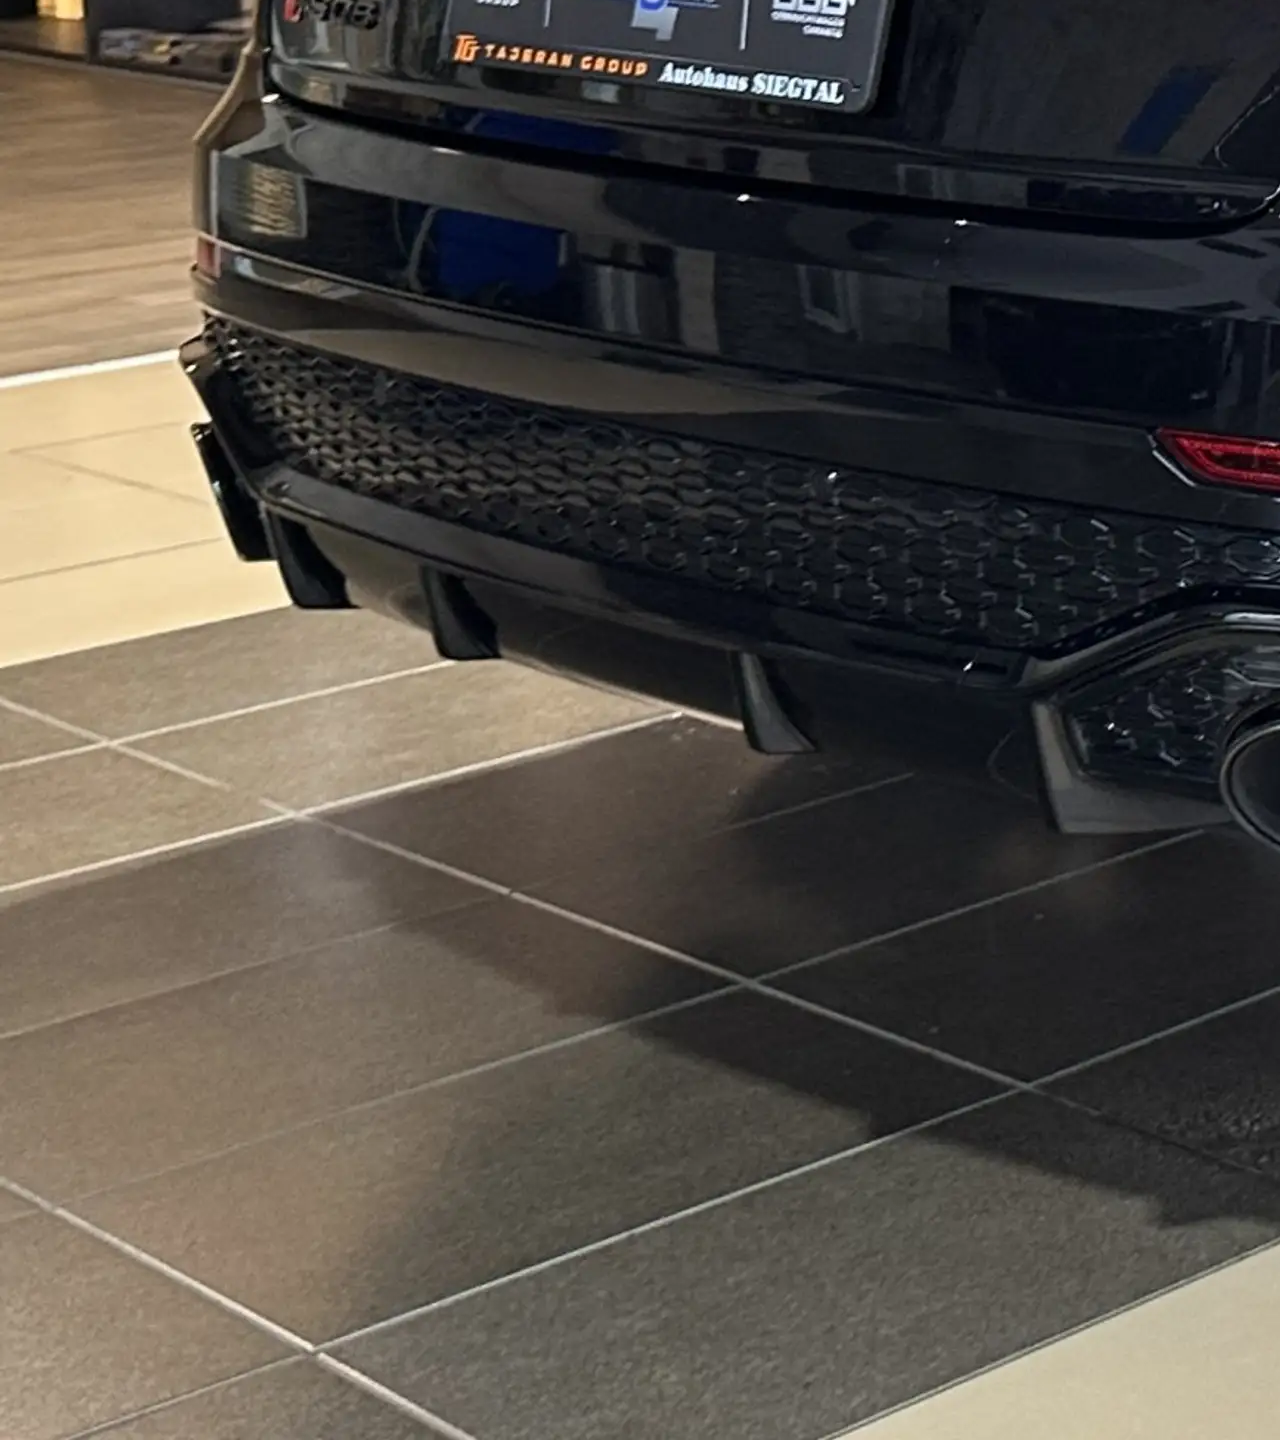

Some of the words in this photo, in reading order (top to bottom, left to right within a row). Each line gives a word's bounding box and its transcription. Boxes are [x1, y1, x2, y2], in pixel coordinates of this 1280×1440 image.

[580, 55, 649, 77] GROUP
[657, 62, 749, 92] Autohaus
[750, 72, 845, 105] SIEGTAL
